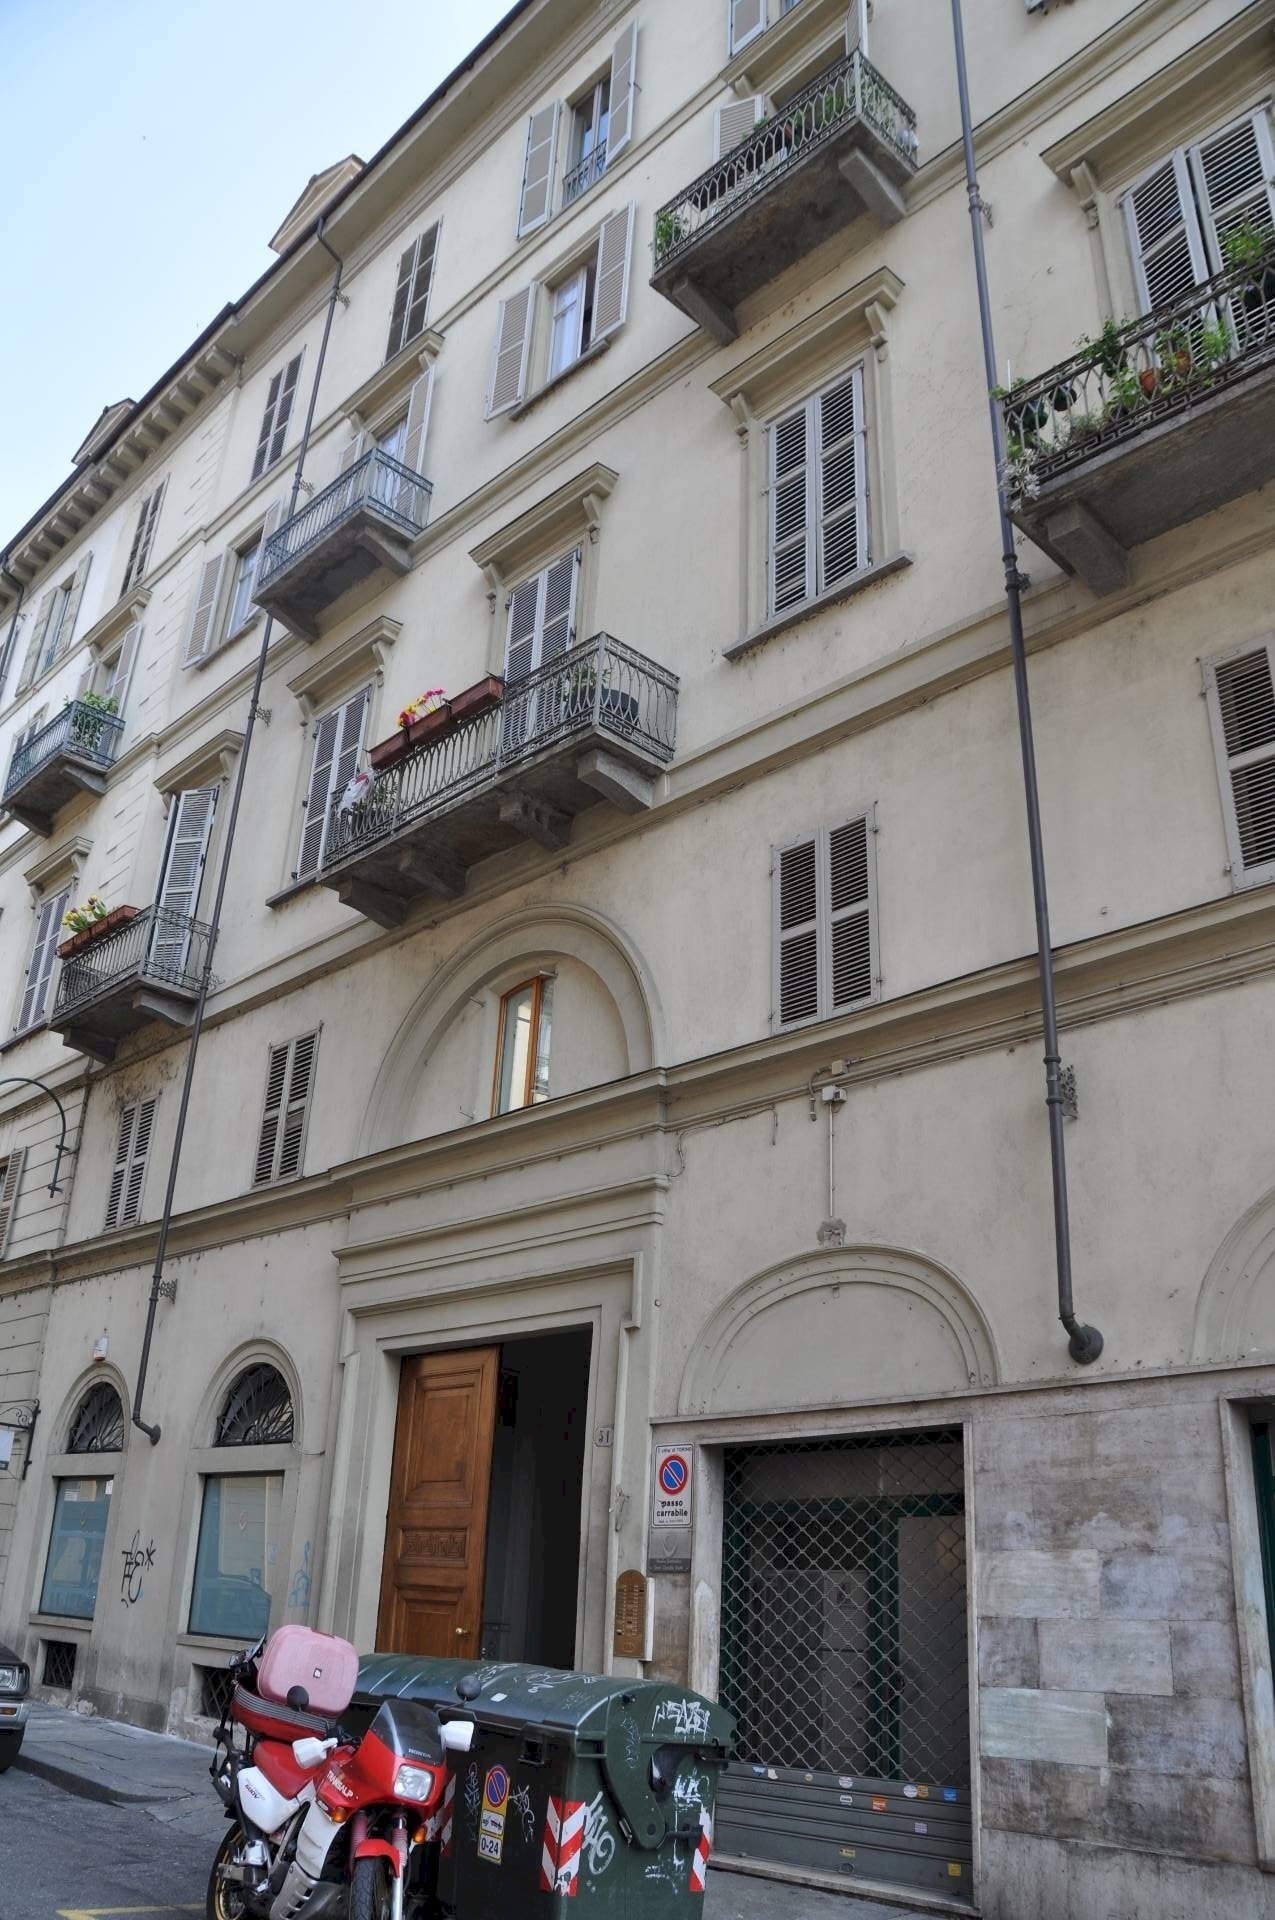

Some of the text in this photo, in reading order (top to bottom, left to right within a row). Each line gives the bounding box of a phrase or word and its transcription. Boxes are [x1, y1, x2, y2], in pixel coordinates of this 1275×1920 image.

[661, 1500, 683, 1508] passo
[656, 1509, 688, 1517] carrabile
[408, 1748, 432, 1759] HONDA
[481, 1837, 499, 1856] 0-24
